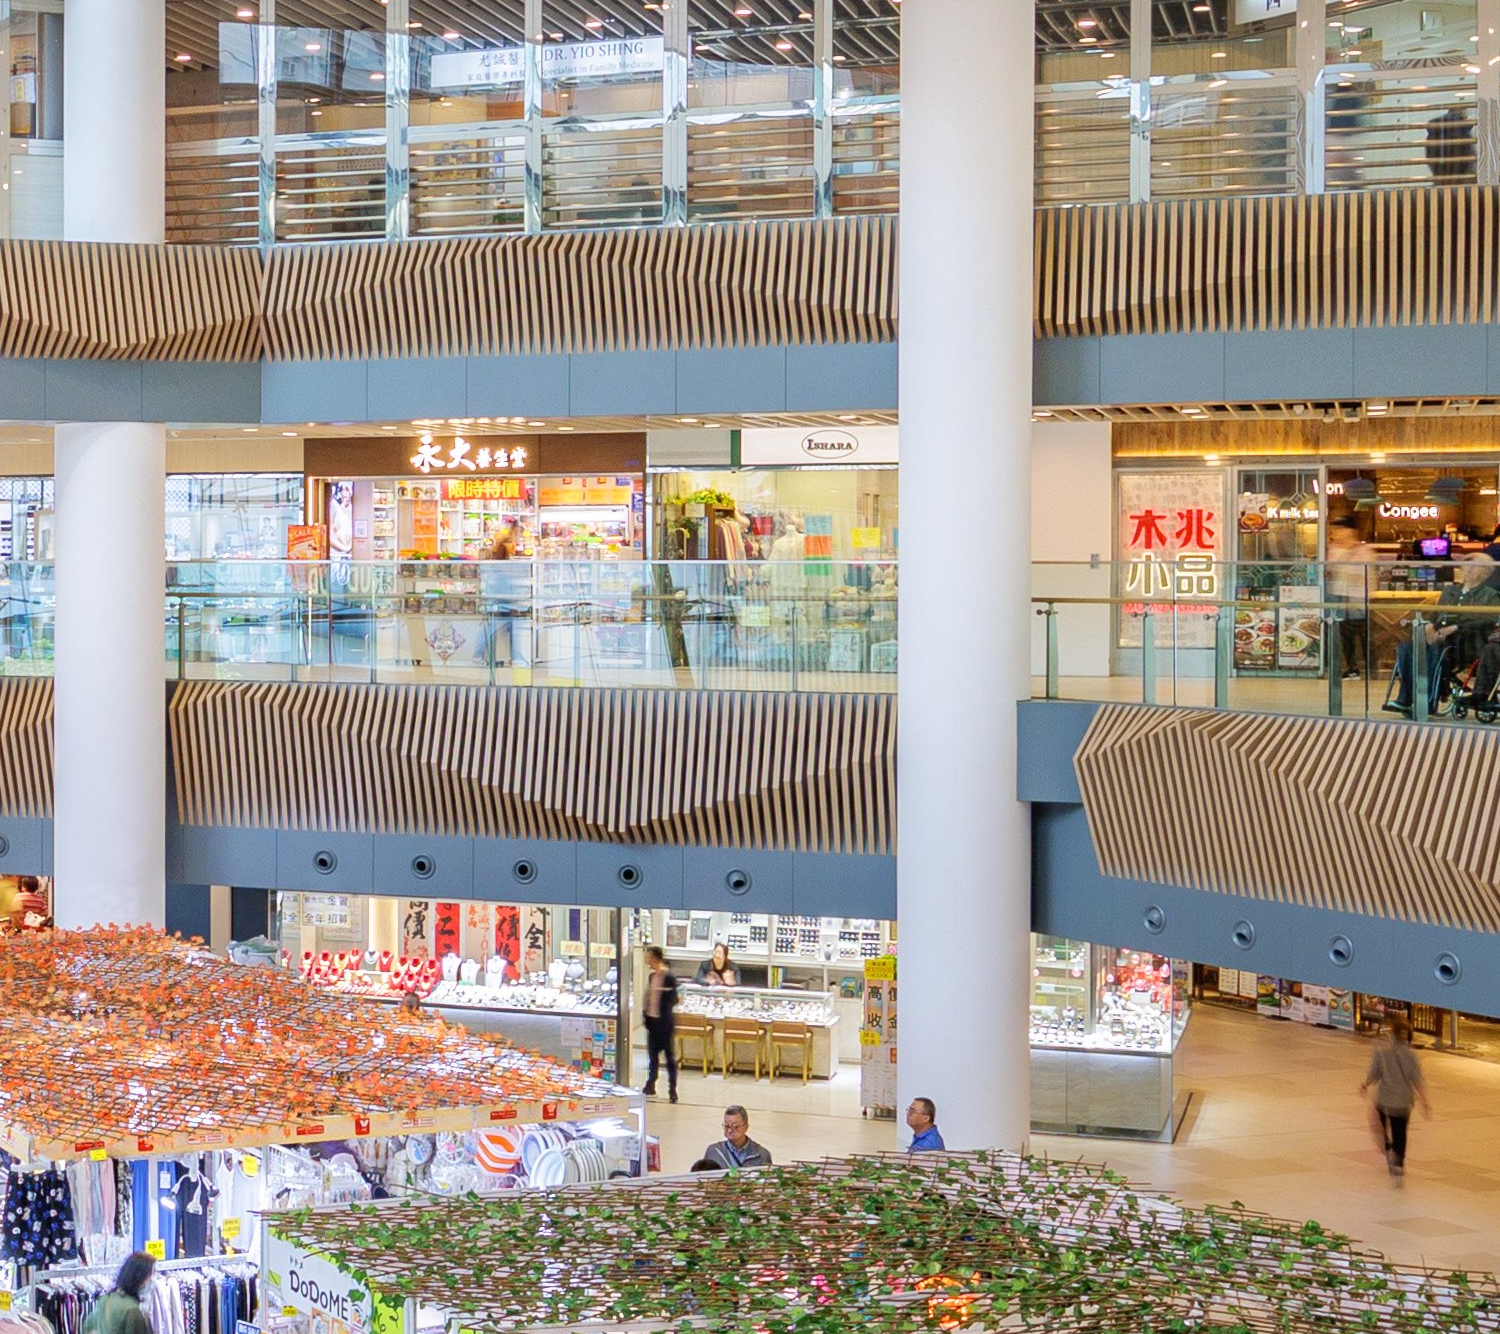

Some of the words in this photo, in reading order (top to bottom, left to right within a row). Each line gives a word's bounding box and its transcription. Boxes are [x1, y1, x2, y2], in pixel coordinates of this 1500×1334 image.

[544, 49, 567, 62] DR.
[571, 46, 594, 59] YIO
[599, 42, 643, 56] SHING
[1379, 502, 1439, 519] Congee
[1130, 509, 1215, 549] 木兆
[1126, 552, 1218, 596] 小品
